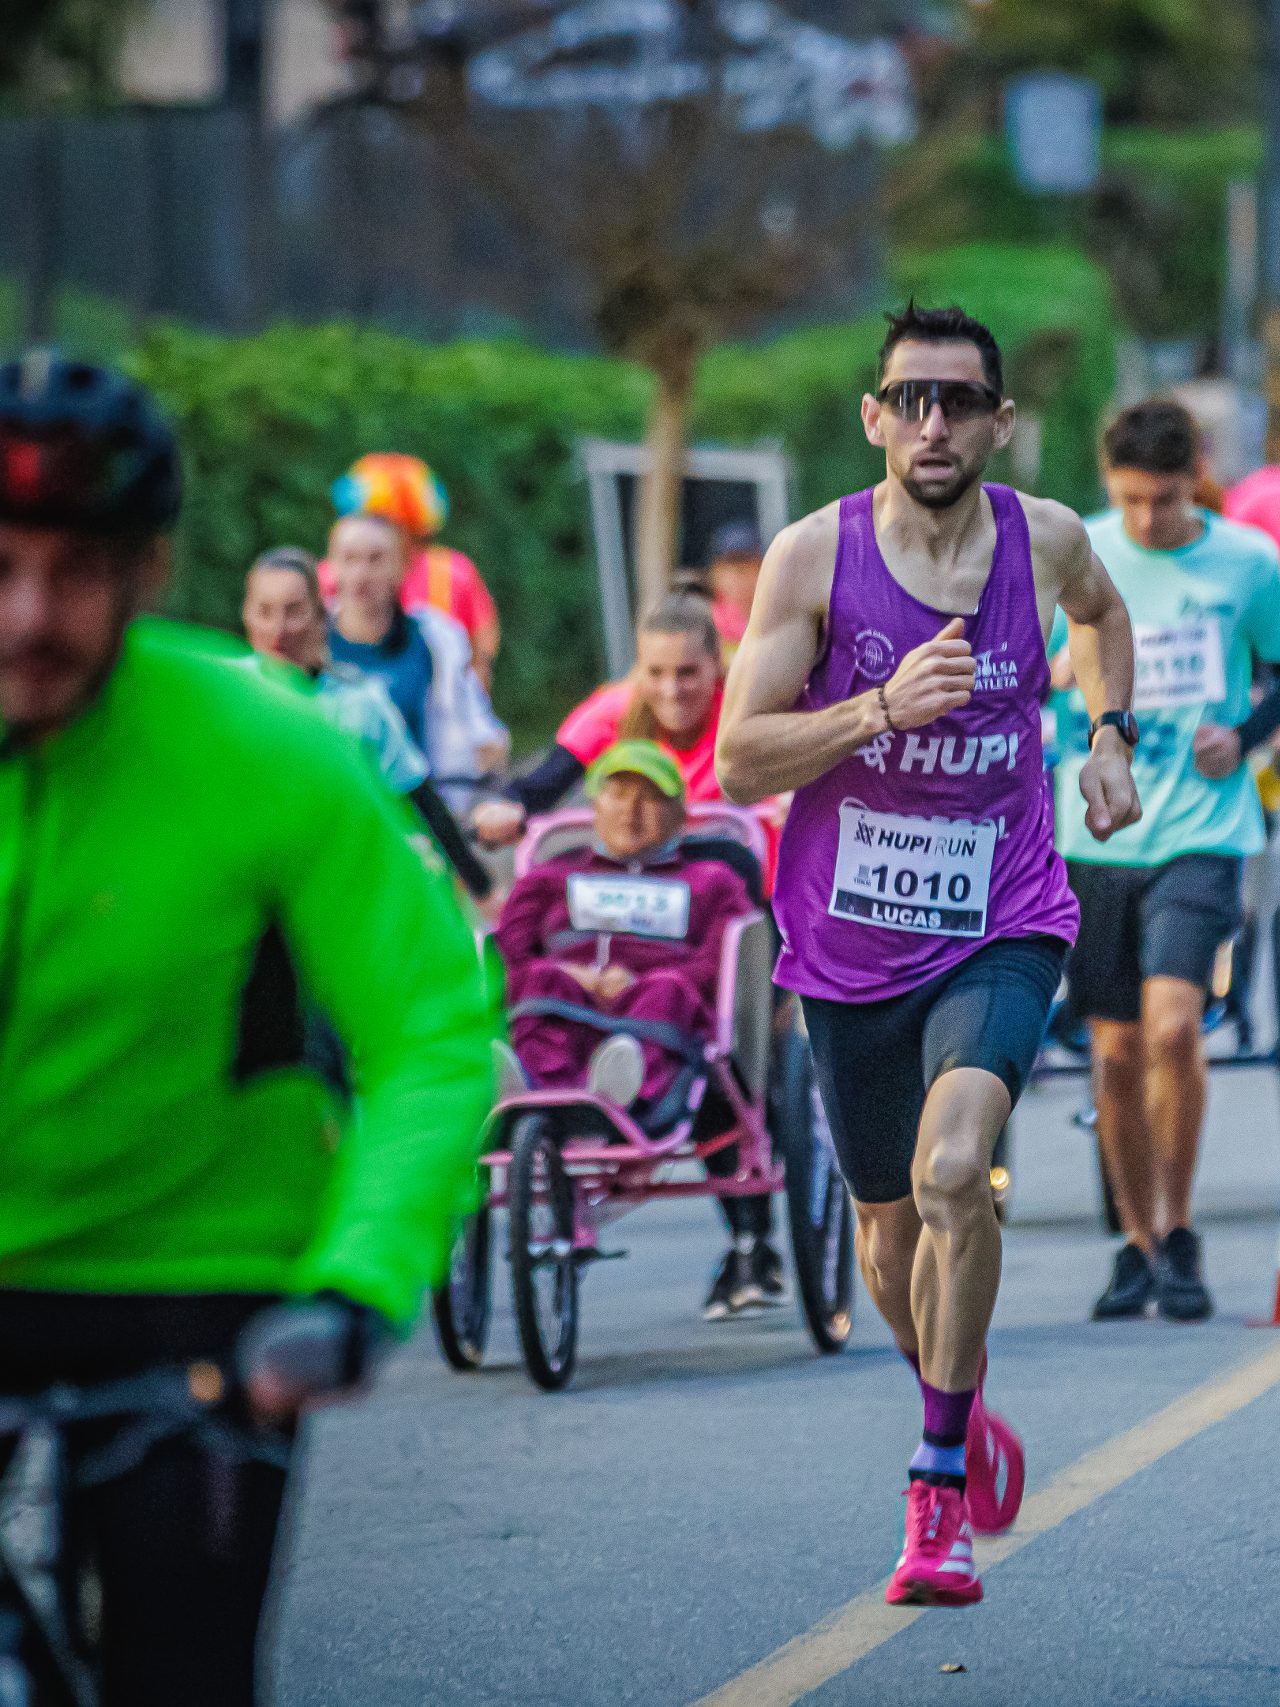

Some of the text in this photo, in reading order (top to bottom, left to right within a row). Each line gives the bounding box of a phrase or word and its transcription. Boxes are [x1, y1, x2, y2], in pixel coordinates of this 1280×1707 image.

[974, 676, 1019, 691] ATLETA
[899, 732, 1019, 775] HUPI
[877, 828, 977, 858] HUPI RUN
[871, 863, 972, 903] 1010
[871, 902, 942, 929] LUCAS
